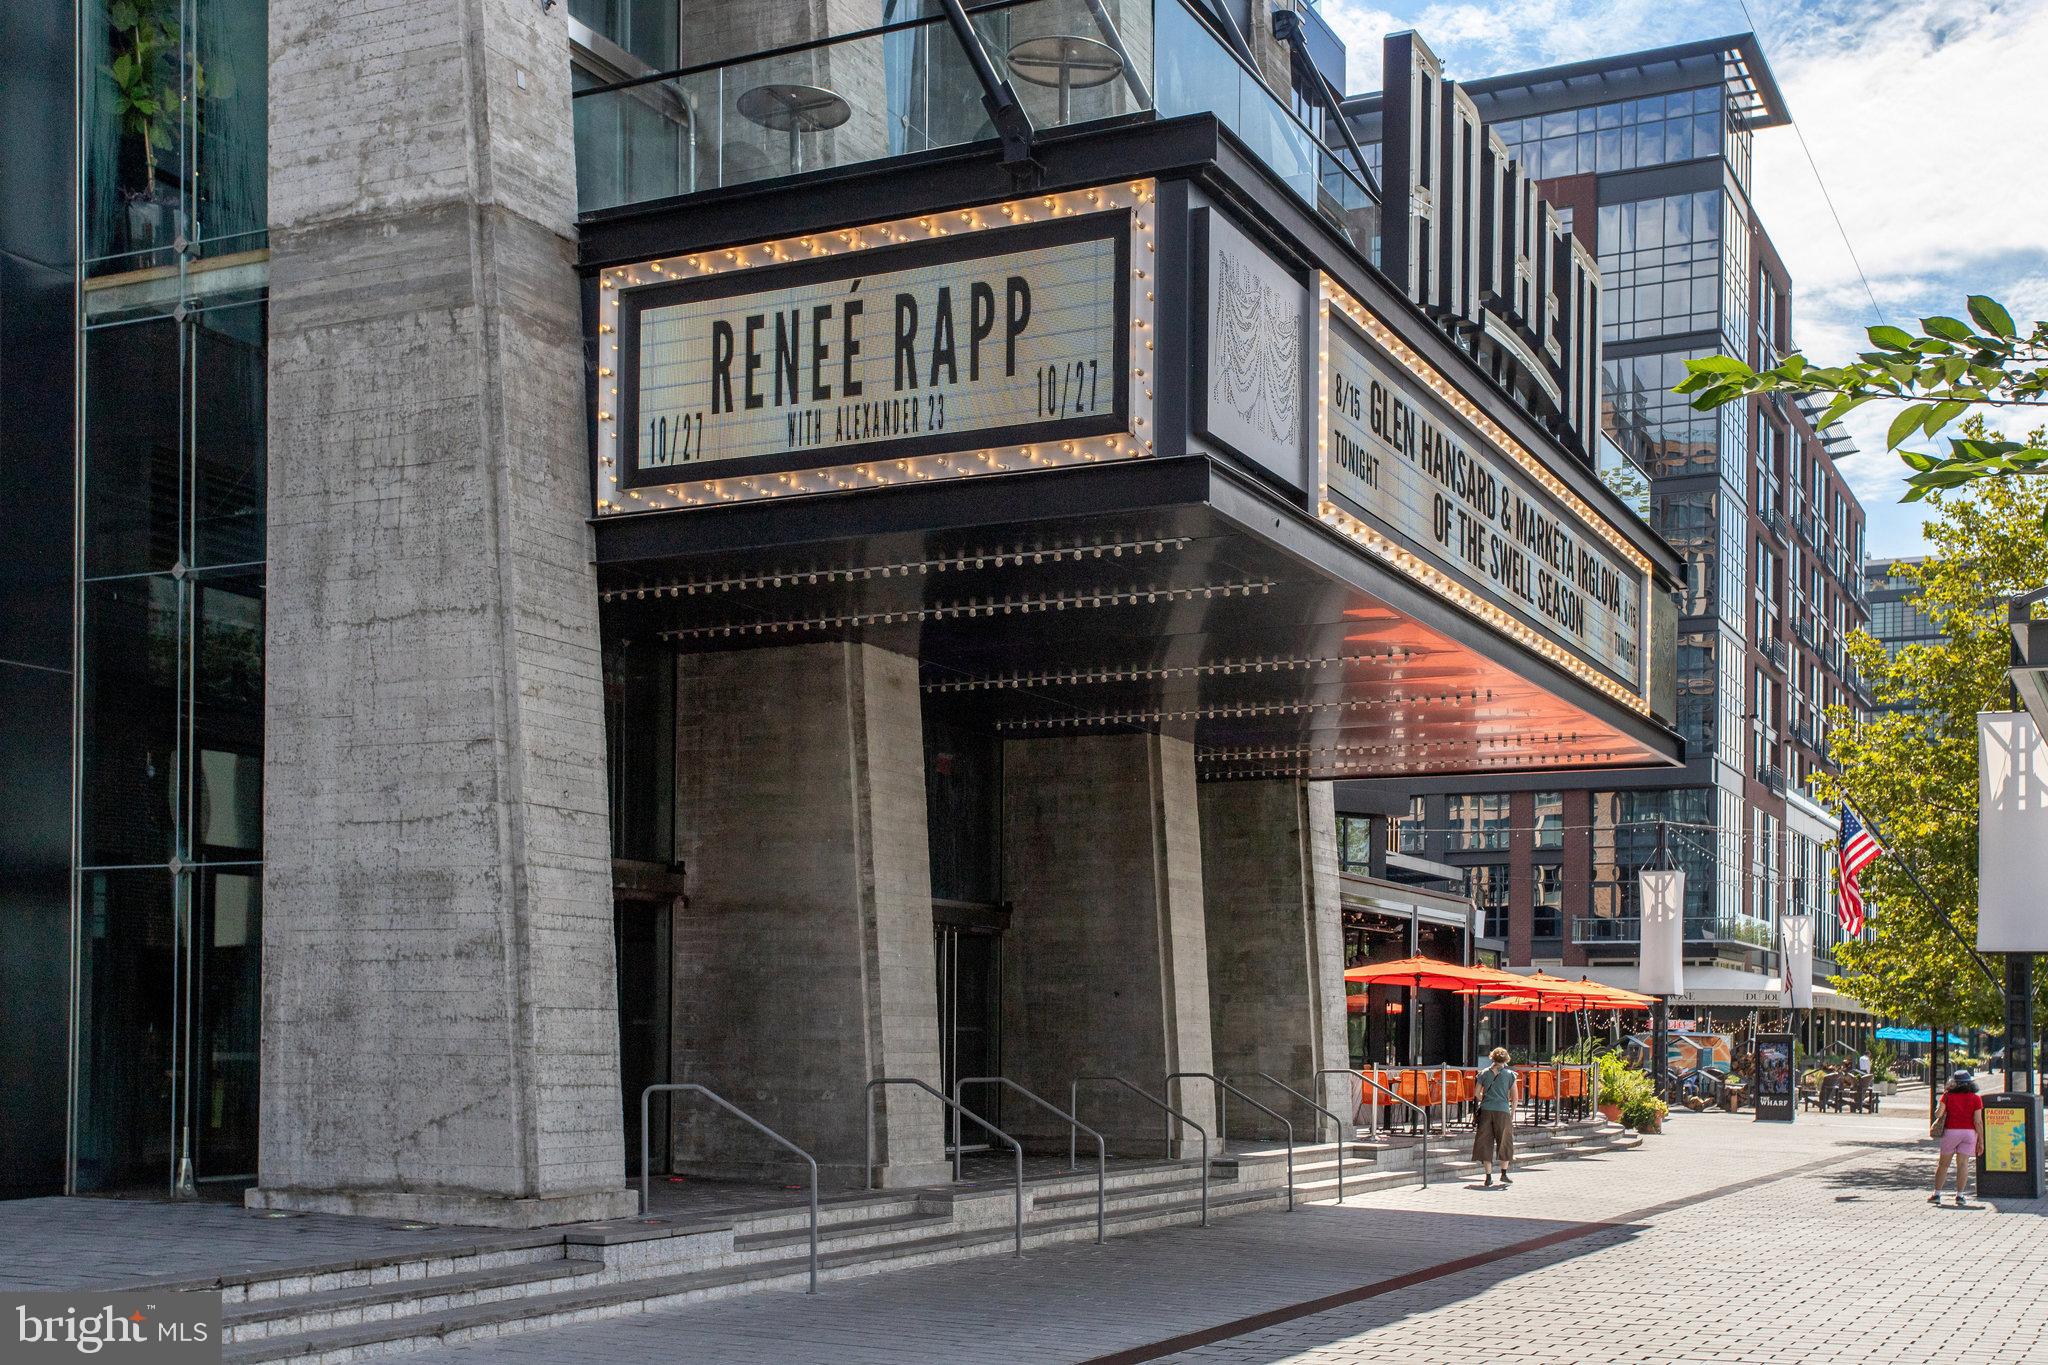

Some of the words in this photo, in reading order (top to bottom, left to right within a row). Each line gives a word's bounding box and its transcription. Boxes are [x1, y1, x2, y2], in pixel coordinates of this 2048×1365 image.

[711, 278, 863, 415] RENEÉ
[895, 275, 1031, 391] RAPP
[1036, 359, 1098, 418] 10/27
[1335, 373, 1360, 421] 8/15
[650, 412, 703, 465] 10/27
[788, 409, 821, 448] WITH
[836, 397, 919, 442] ALEXANDER
[928, 393, 944, 431] 23
[1334, 429, 1380, 490] TONIGHT
[1370, 380, 1415, 462] GLEN
[1421, 419, 1496, 521] HANSARD
[1500, 486, 1511, 535] &
[1515, 497, 1575, 582] MARKÉTA
[1578, 548, 1620, 617] IRGLOVÁ
[1433, 492, 1454, 548] OF
[1457, 508, 1486, 573] THE
[1490, 533, 1534, 605] SWELL
[1537, 568, 1584, 638] SEASON
